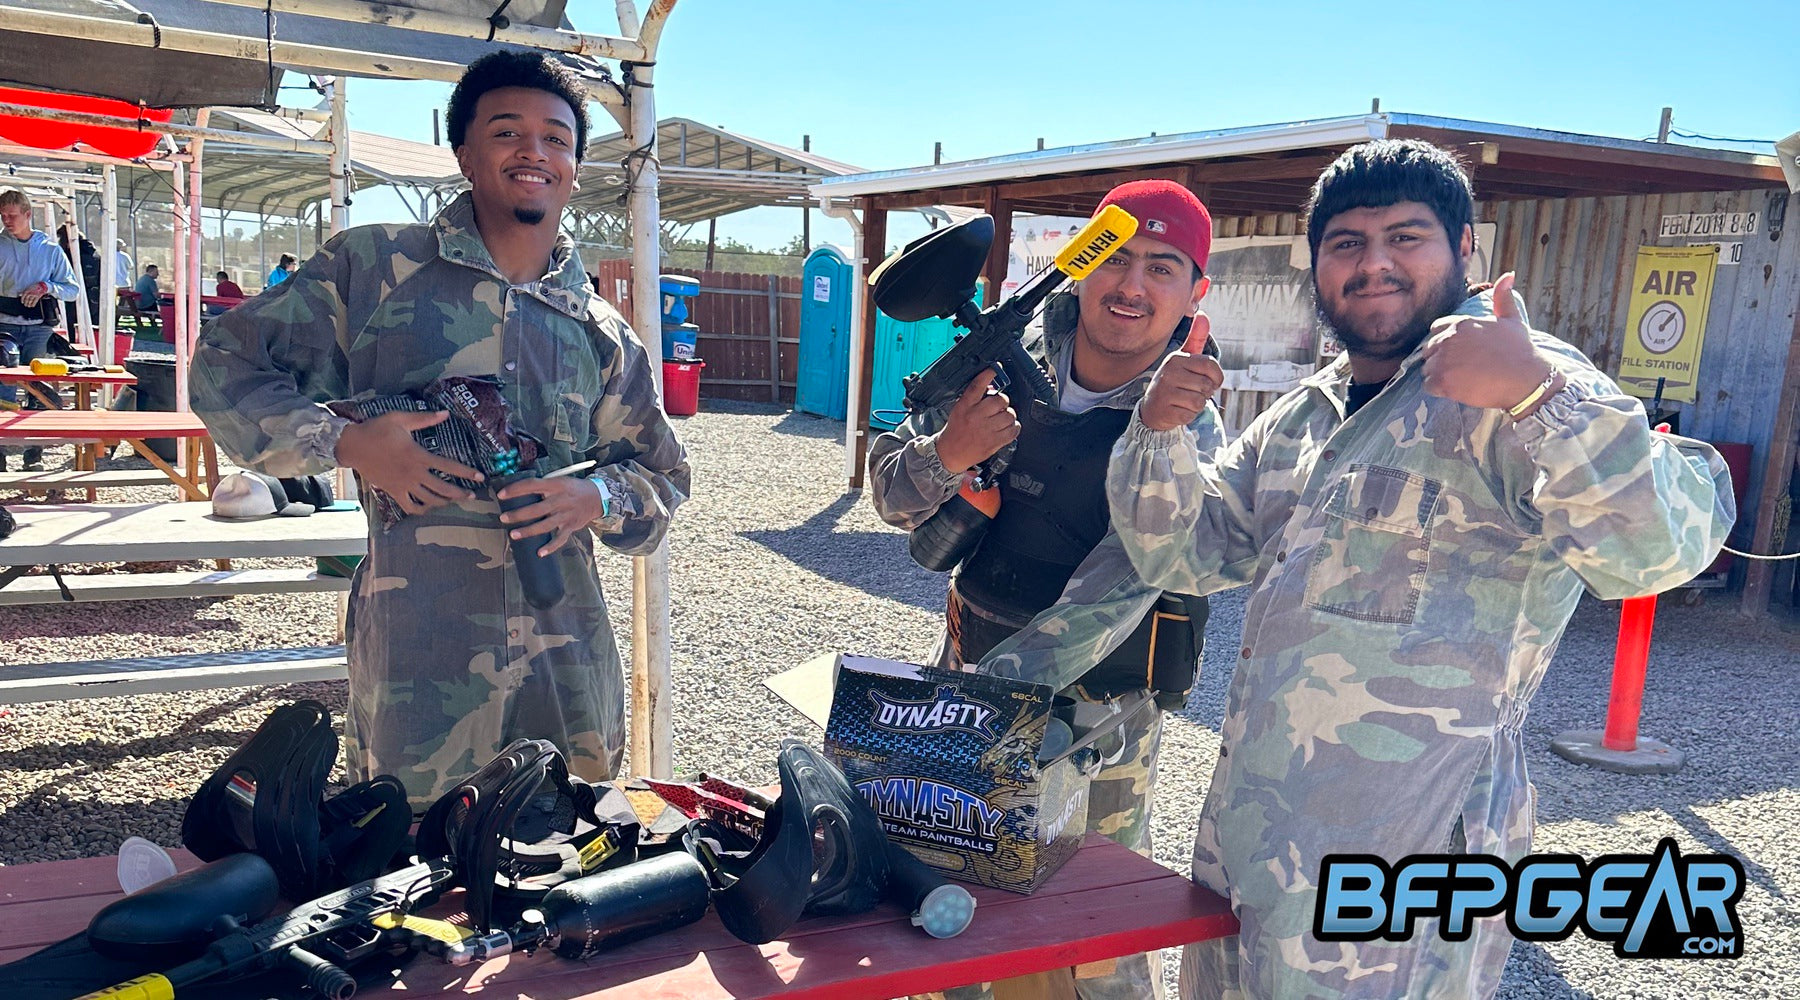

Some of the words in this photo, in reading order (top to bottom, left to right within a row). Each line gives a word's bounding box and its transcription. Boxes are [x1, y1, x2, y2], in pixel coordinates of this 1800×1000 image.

[1067, 229, 1119, 270] RENTAL
[1640, 269, 1697, 296] AIR
[1621, 357, 1641, 367] FILL
[1645, 359, 1690, 372] STATION
[456, 383, 479, 408] 500
[879, 699, 990, 729] DYNASTY
[833, 747, 857, 757] 2000
[858, 752, 887, 763] COUNT
[884, 822, 917, 837] TEAM
[920, 829, 994, 852] PAINTBALLS
